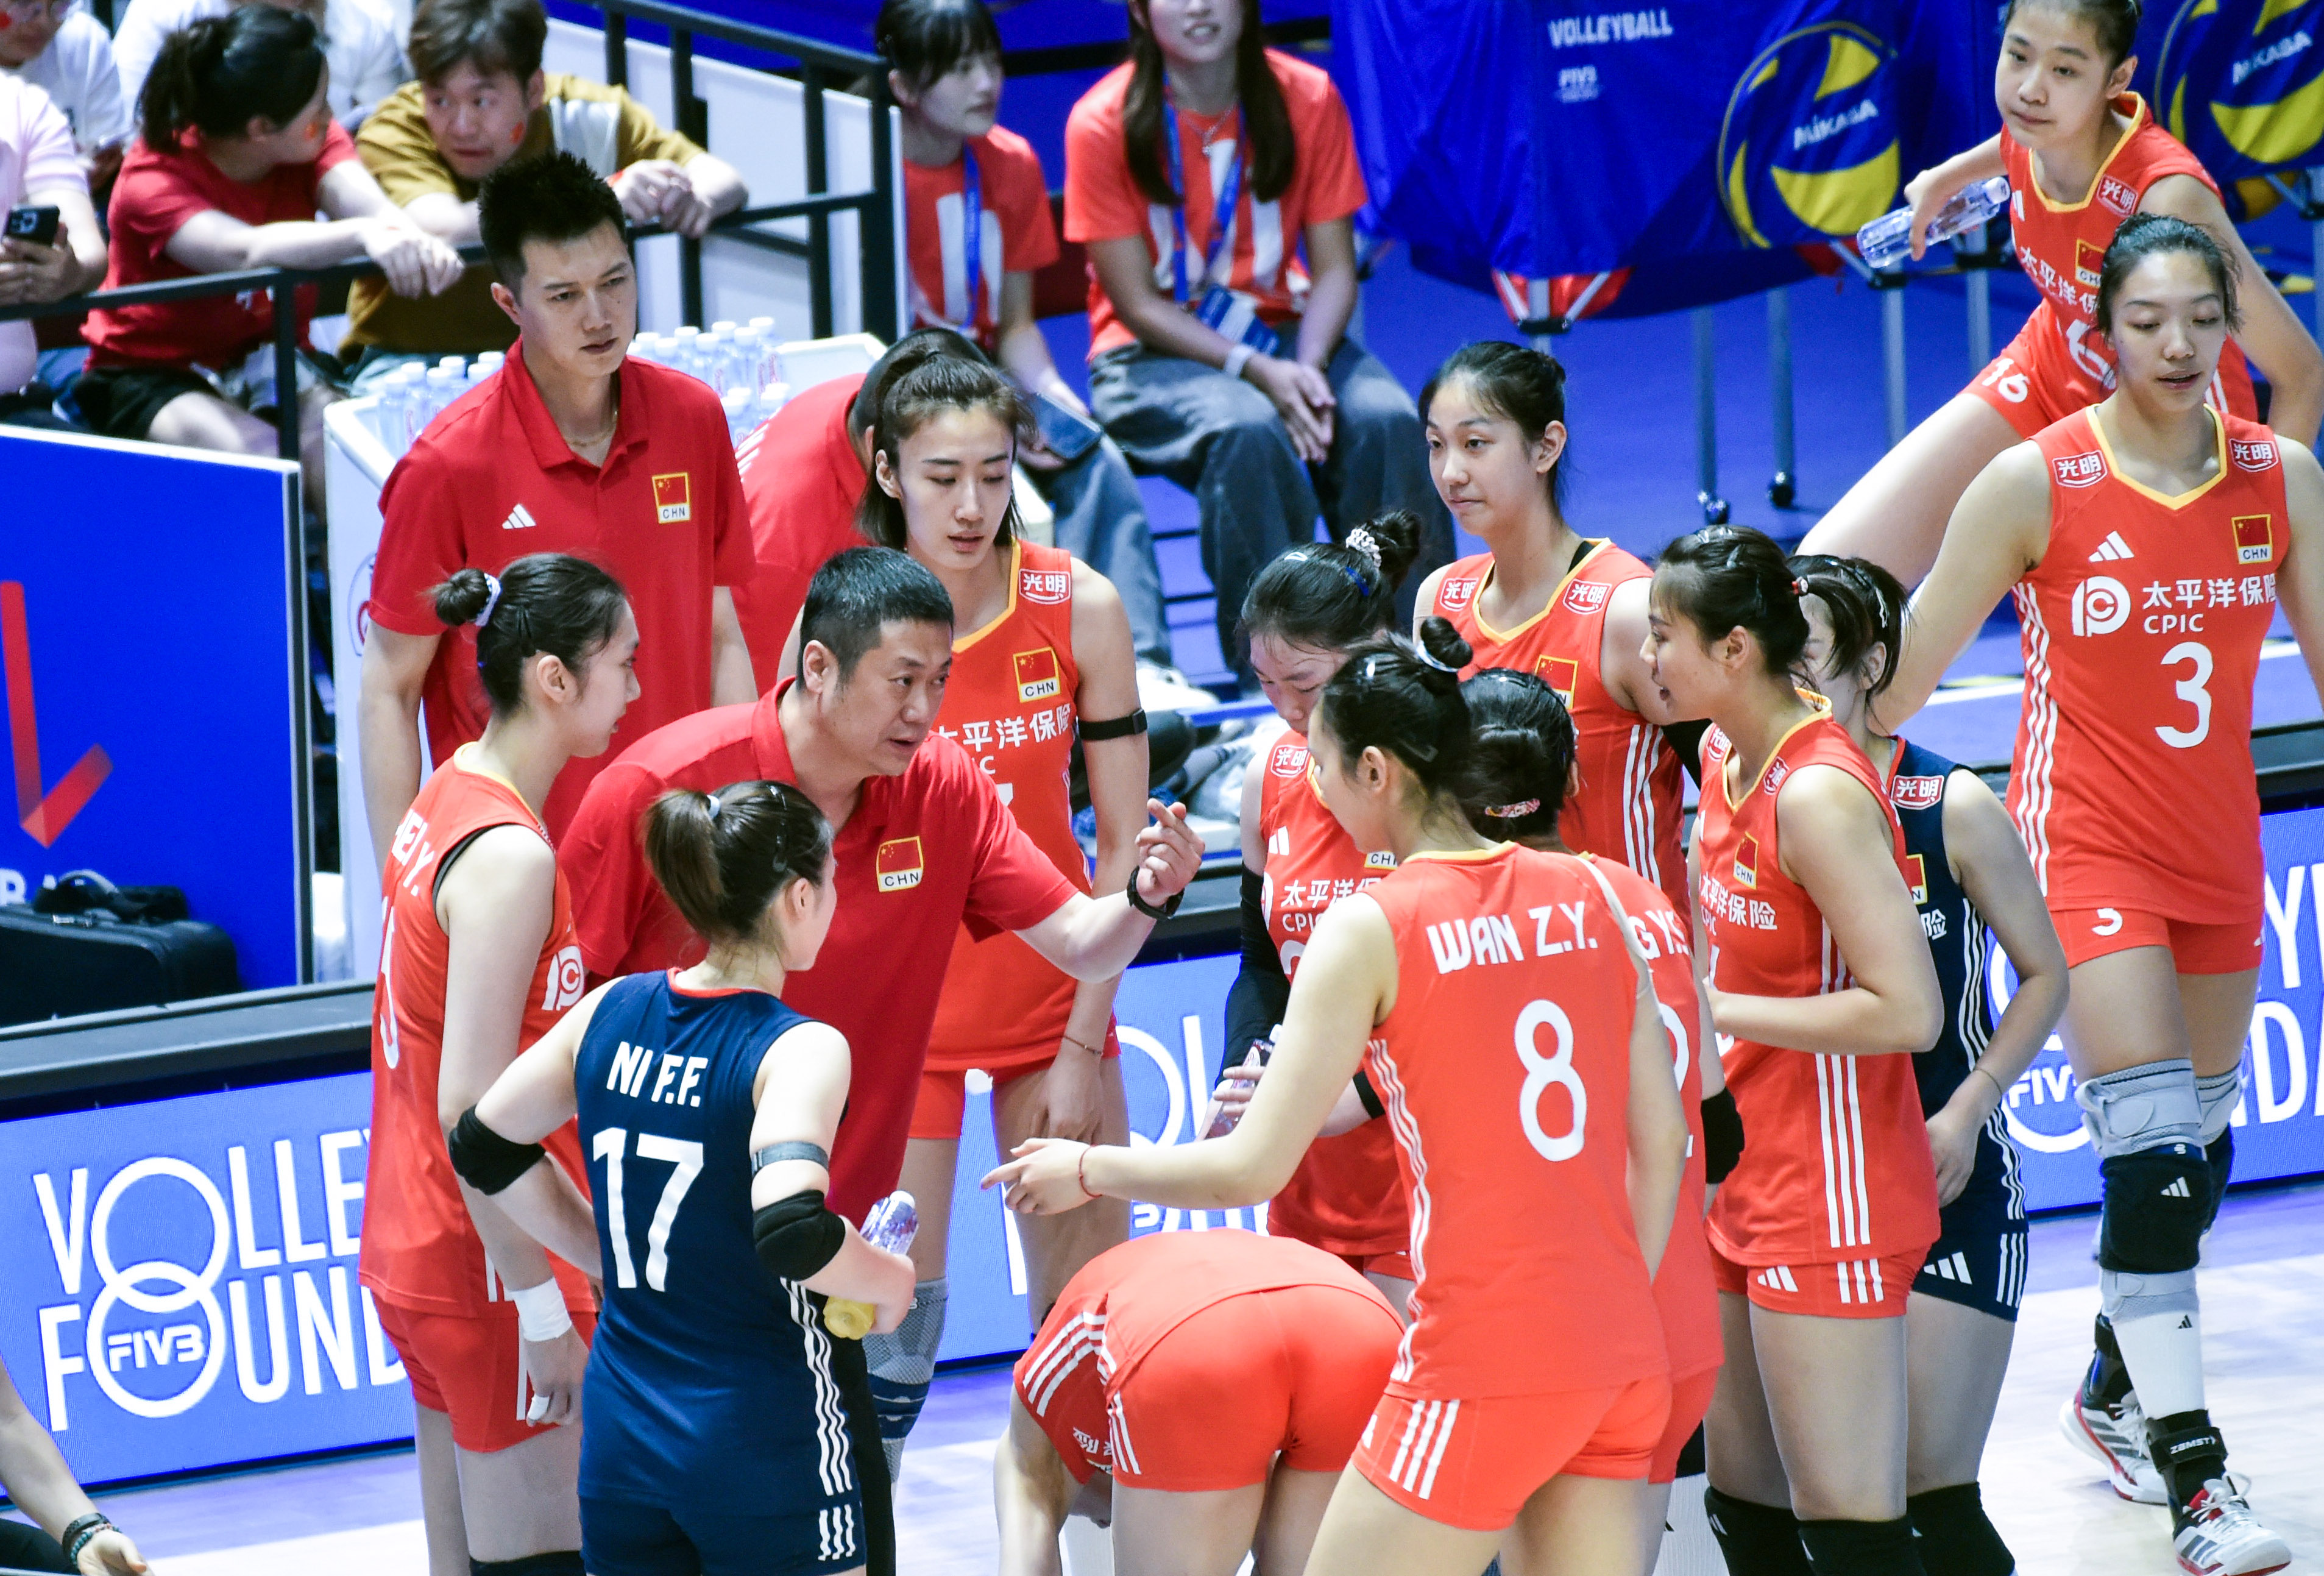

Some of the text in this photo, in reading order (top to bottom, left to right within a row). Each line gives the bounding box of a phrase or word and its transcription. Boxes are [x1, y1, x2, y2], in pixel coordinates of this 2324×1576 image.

[1548, 7, 1673, 49] VOLLEYBALL
[2102, 179, 2134, 207] 光明
[1982, 358, 2030, 403] 16
[2233, 443, 2274, 461] 光明
[2057, 454, 2102, 478] 光明
[662, 508, 686, 519] CHN
[2242, 547, 2268, 560] CHN
[1022, 573, 1067, 594] 光明
[1569, 583, 1607, 603] 光明
[2144, 614, 2204, 634] CPIC
[1025, 681, 1055, 697] CHN
[2155, 641, 2214, 749] 3
[1275, 747, 1308, 767] 光明
[1896, 779, 1940, 798] 光明
[884, 871, 919, 887] CHN
[1736, 865, 1752, 884] CHN
[1701, 871, 1778, 930] 太平洋保险
[1425, 901, 1598, 974] WAN Z.Y.
[606, 1041, 709, 1108] NI F.F.
[1514, 998, 1587, 1162] 8
[2010, 1063, 2079, 1109] FIV
[33, 1129, 370, 1310] VOLLE
[593, 1126, 704, 1293] 17
[107, 1324, 206, 1372] FIVB
